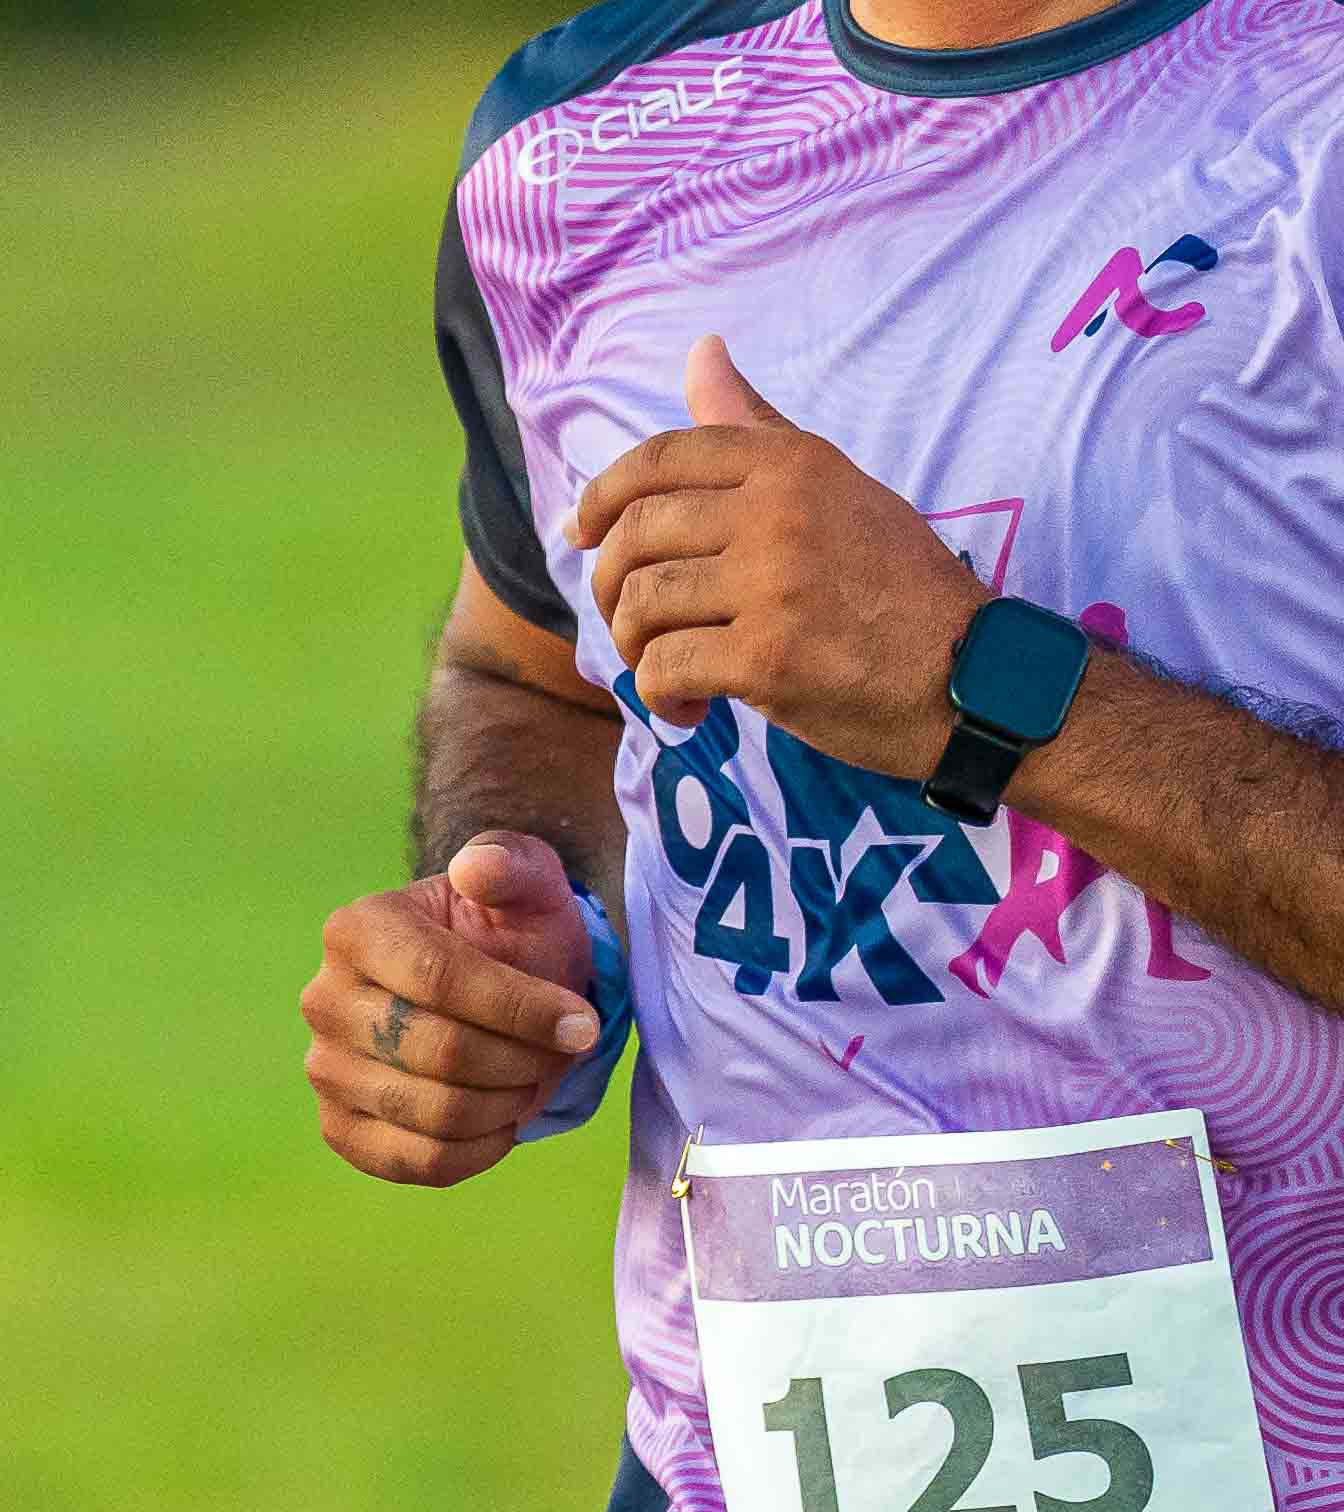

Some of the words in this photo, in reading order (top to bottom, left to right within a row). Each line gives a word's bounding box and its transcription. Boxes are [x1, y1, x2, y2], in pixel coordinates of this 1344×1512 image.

[693, 831, 946, 1006] 4K
[769, 1166, 936, 1217] Maratón
[774, 1209, 1066, 1269] NOCTURNA
